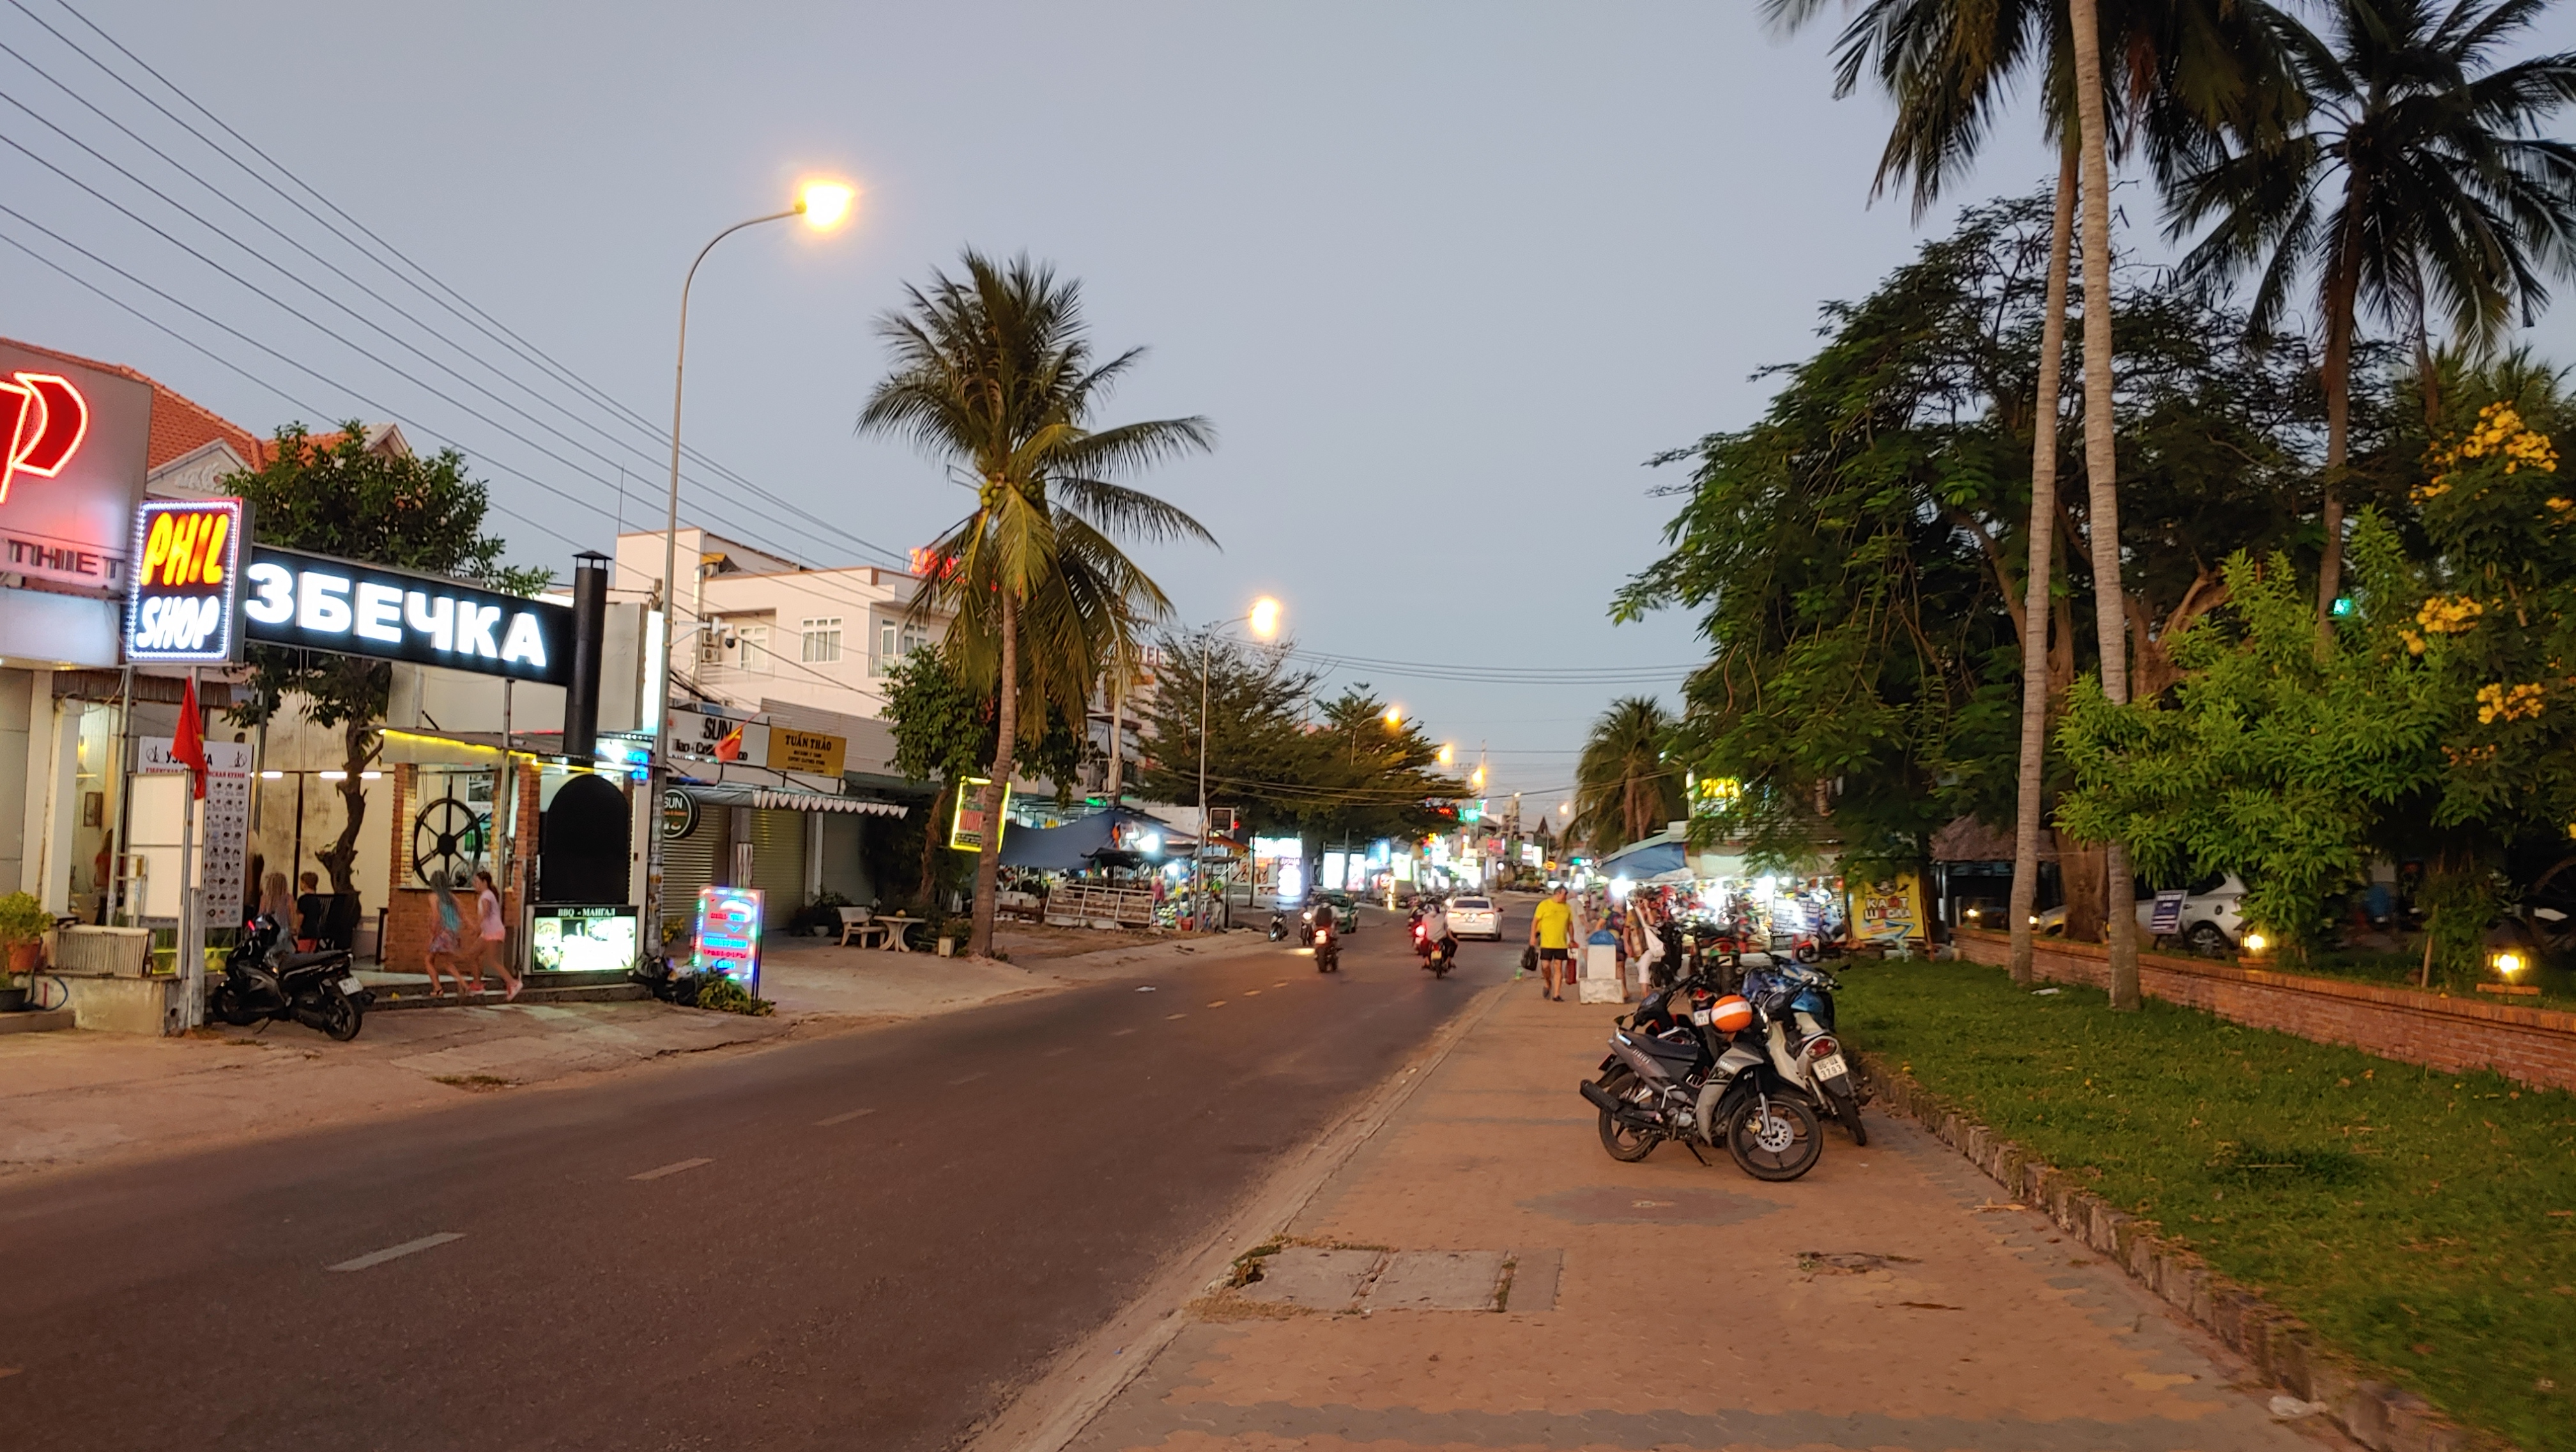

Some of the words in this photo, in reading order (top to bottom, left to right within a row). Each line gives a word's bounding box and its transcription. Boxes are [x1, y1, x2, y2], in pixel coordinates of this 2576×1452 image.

[139, 512, 229, 586] PHIL
[135, 596, 220, 650] SHOP
[245, 562, 547, 667] ЗБЕЧКА
[702, 717, 733, 740] SUN
[664, 796, 683, 809] SUN
[558, 908, 575, 917] BBQ
